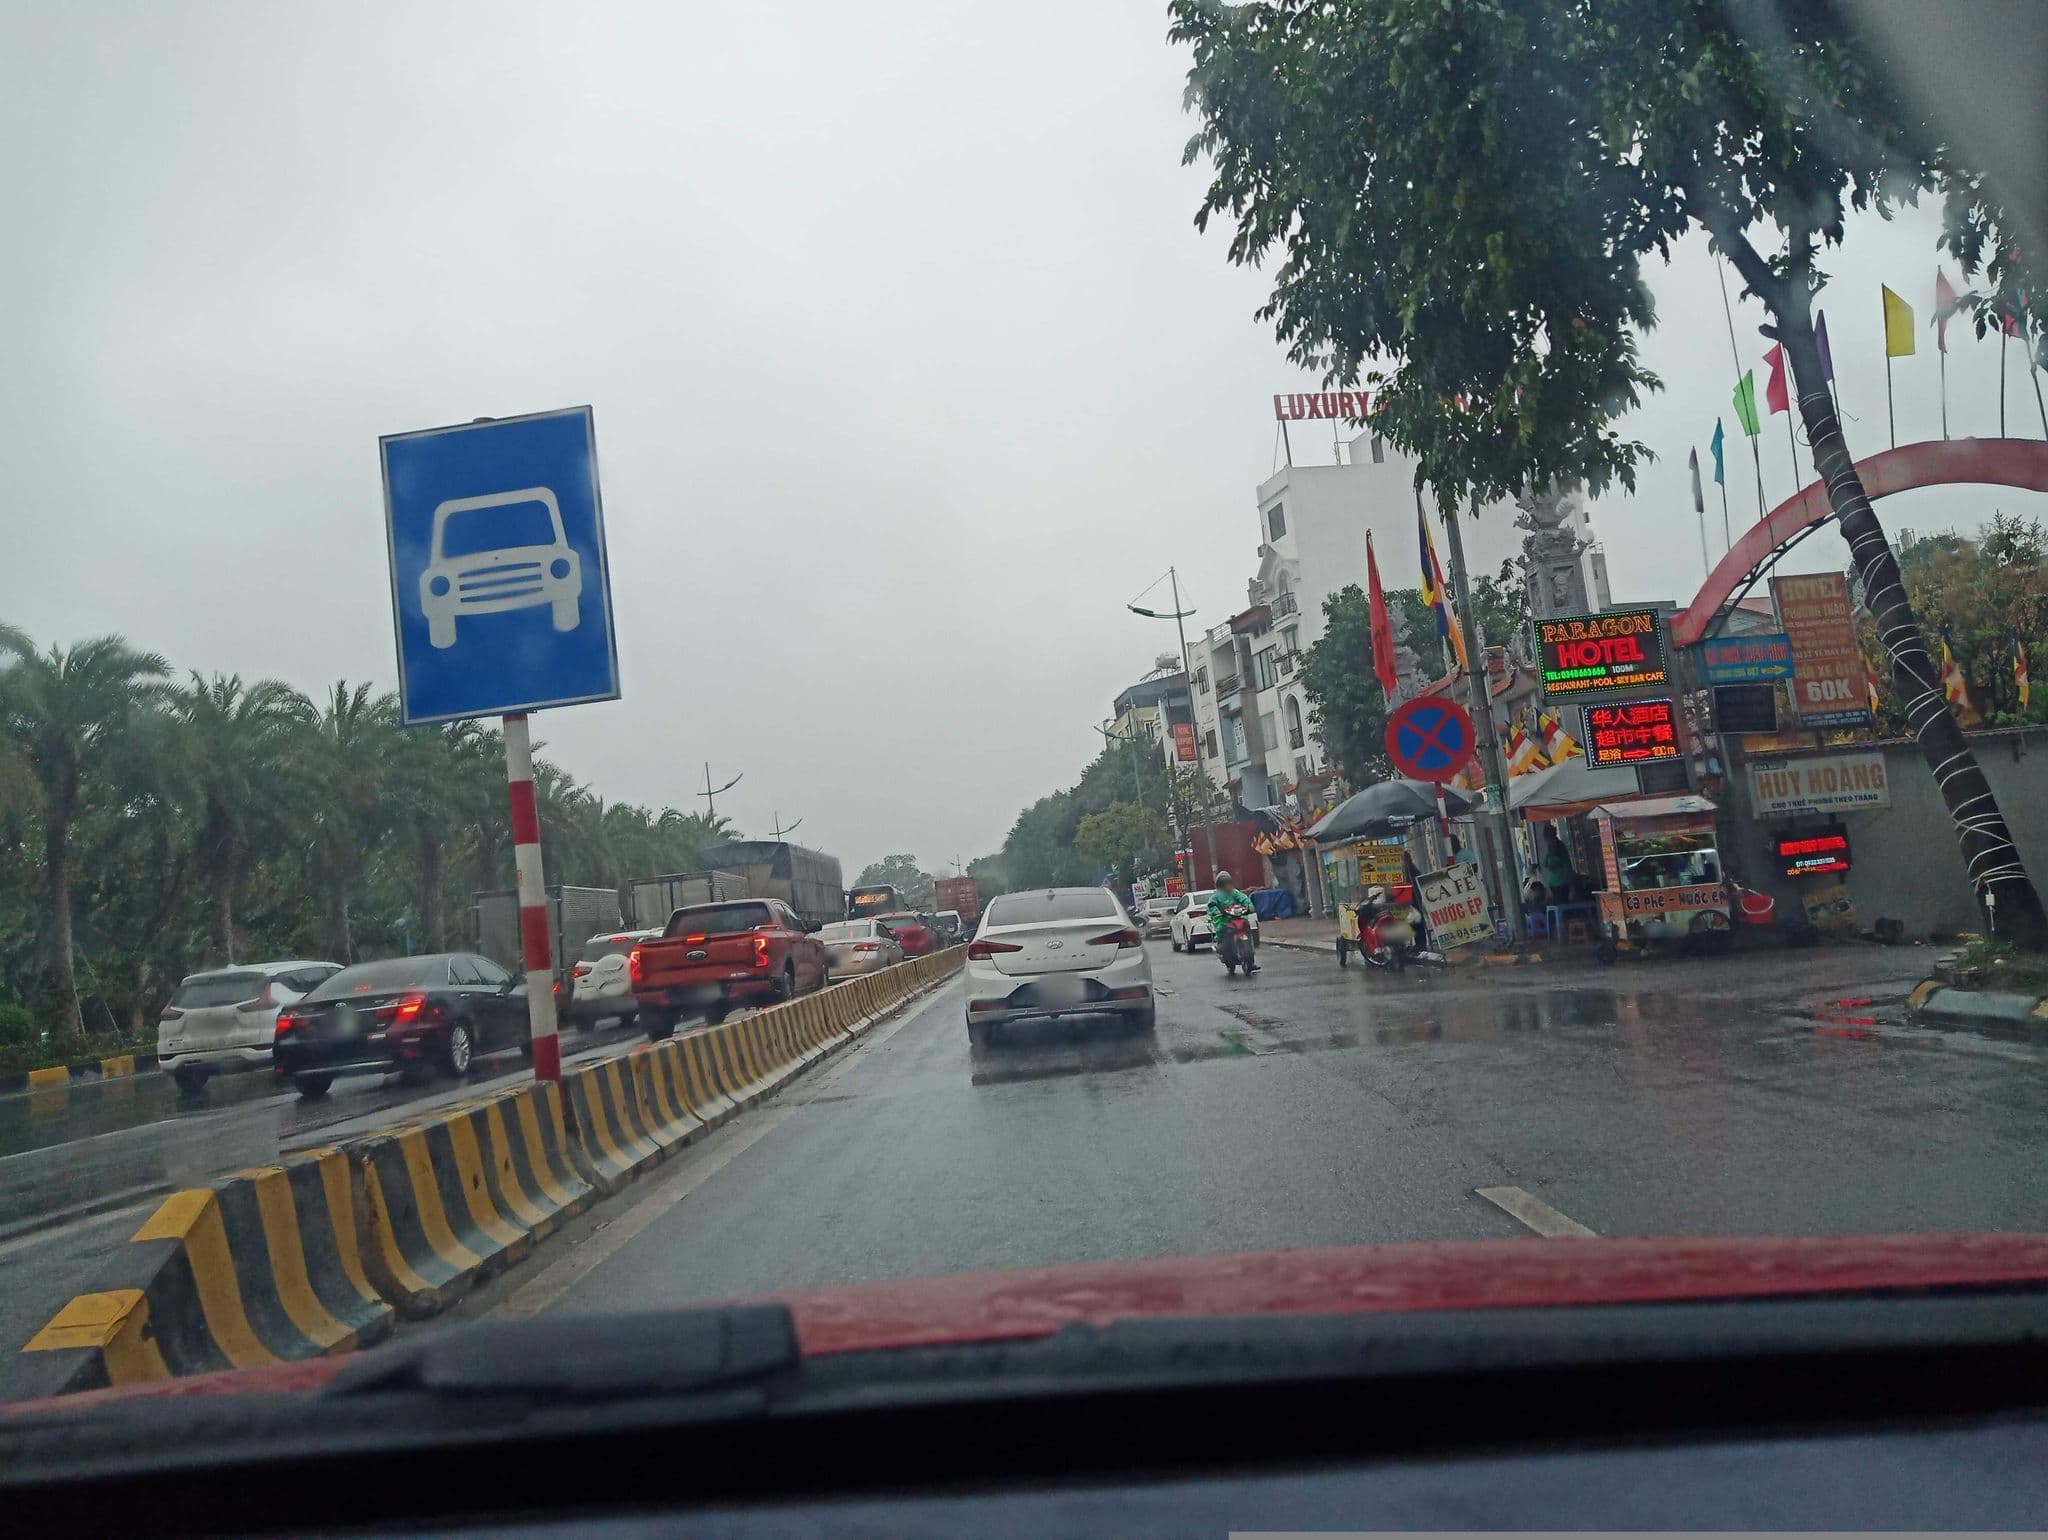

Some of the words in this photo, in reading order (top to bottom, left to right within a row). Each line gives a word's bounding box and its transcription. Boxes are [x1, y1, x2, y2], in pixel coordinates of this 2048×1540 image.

[1273, 391, 1370, 421] LUXURY
[1542, 614, 1653, 643] PARAGON
[1557, 636, 1645, 668] HOTEL
[1646, 671, 1665, 681] CAFE
[1806, 678, 1854, 702] 60K
[1591, 704, 1669, 727] 华人酒店
[1756, 769, 1801, 799] HUY
[1425, 876, 1476, 903] CAFE
